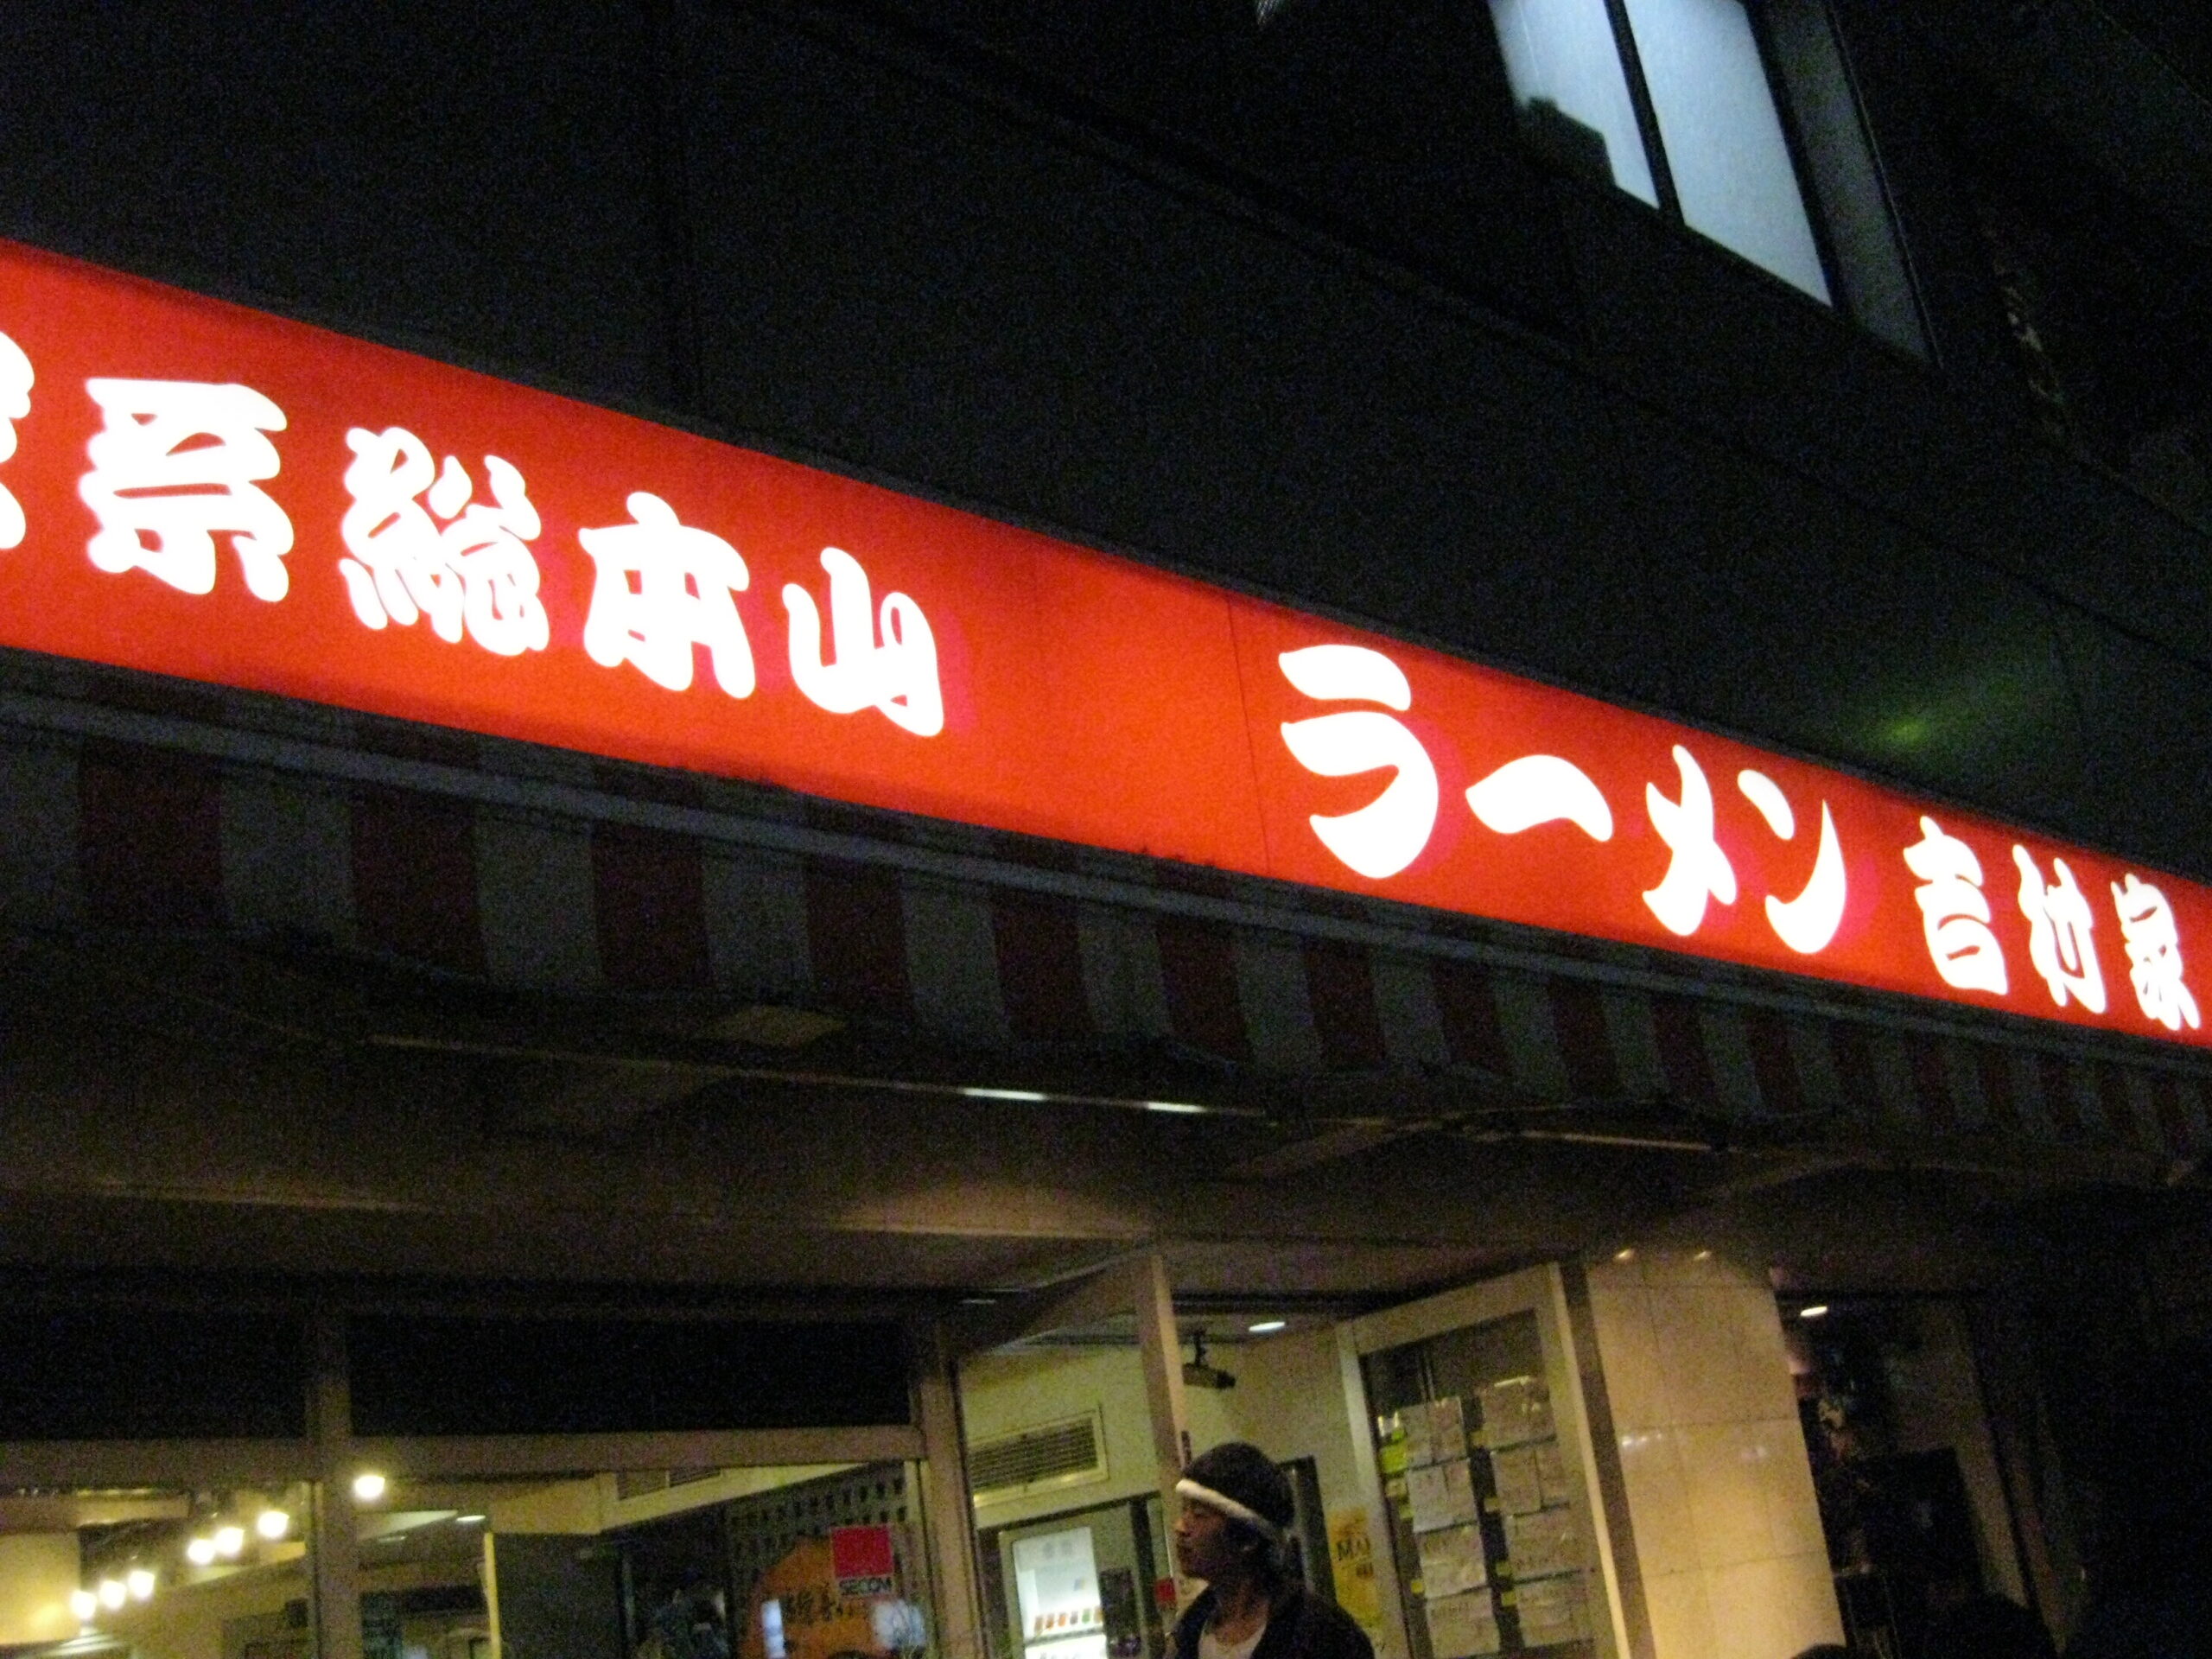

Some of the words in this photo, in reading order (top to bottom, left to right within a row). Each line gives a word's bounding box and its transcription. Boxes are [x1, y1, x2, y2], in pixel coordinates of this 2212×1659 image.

[0, 332, 944, 736] 系総本山
[1279, 644, 1847, 955] ラーメン
[1904, 816, 2201, 1032] 吉村家
